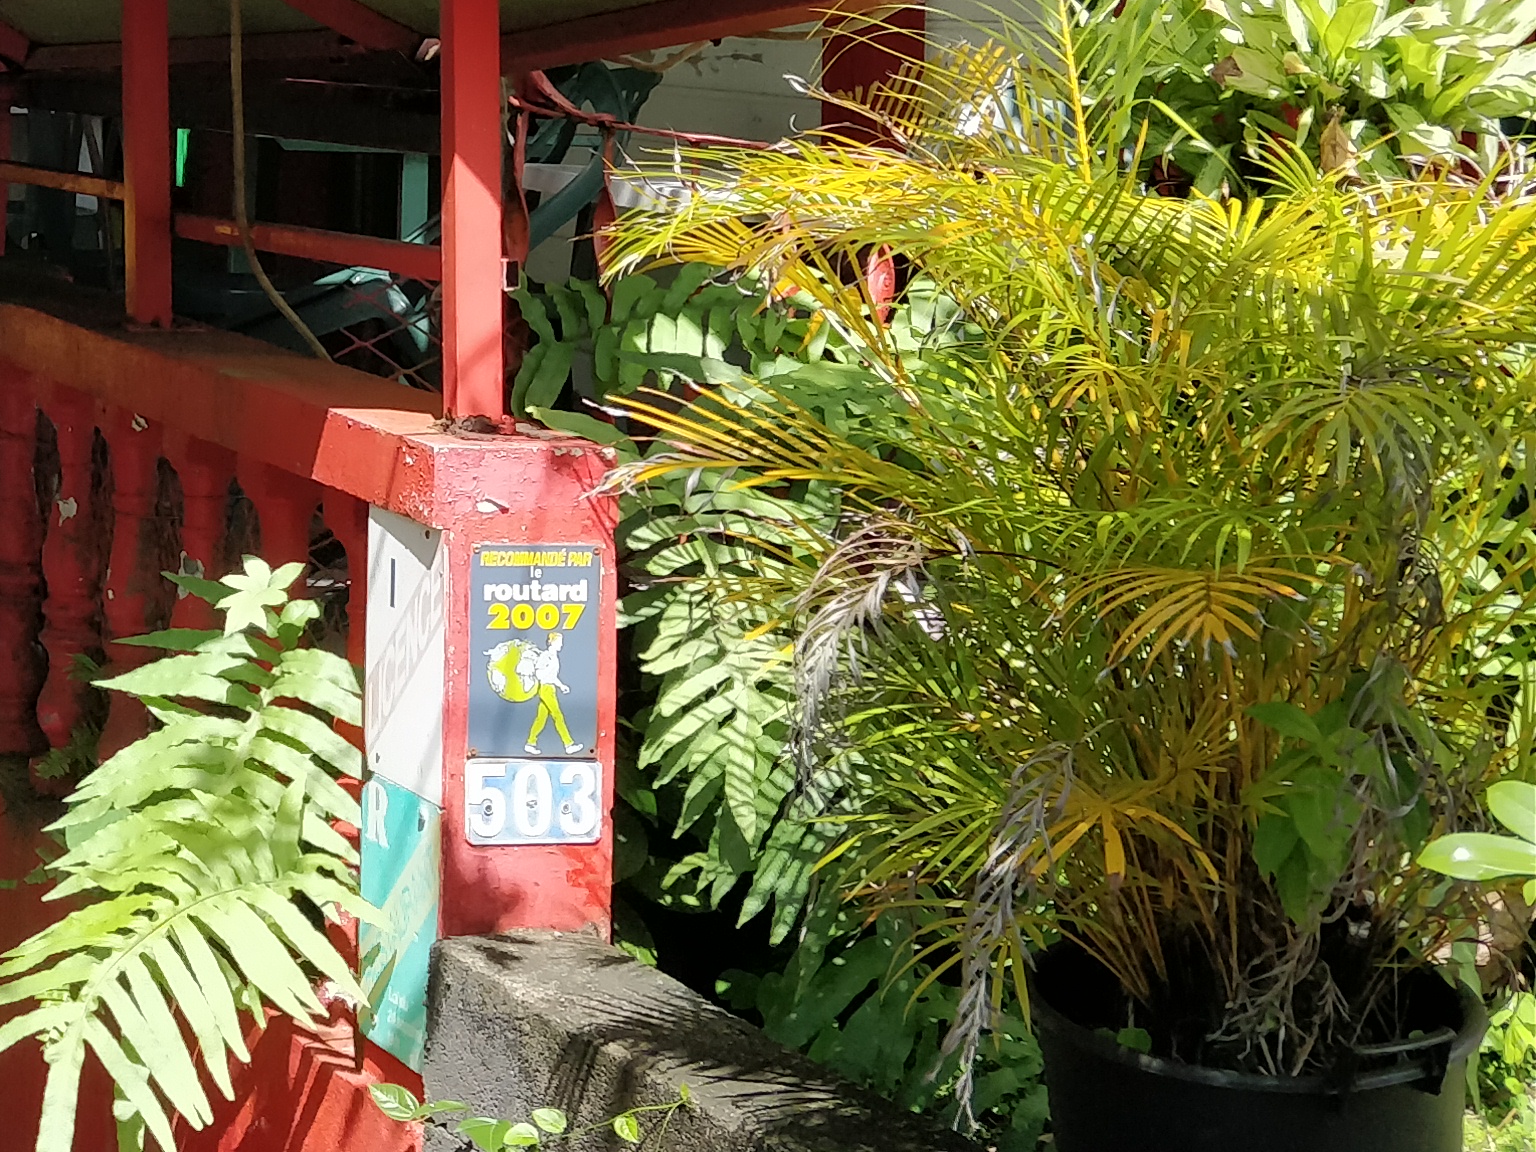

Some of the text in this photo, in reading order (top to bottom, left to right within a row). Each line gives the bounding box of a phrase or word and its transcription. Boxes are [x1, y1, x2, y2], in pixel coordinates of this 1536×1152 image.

[480, 548, 593, 567] RECOMMANDÉ PAR
[530, 565, 543, 579] le
[483, 579, 588, 602] routard
[486, 603, 586, 630] 2007
[469, 763, 598, 839] 503
